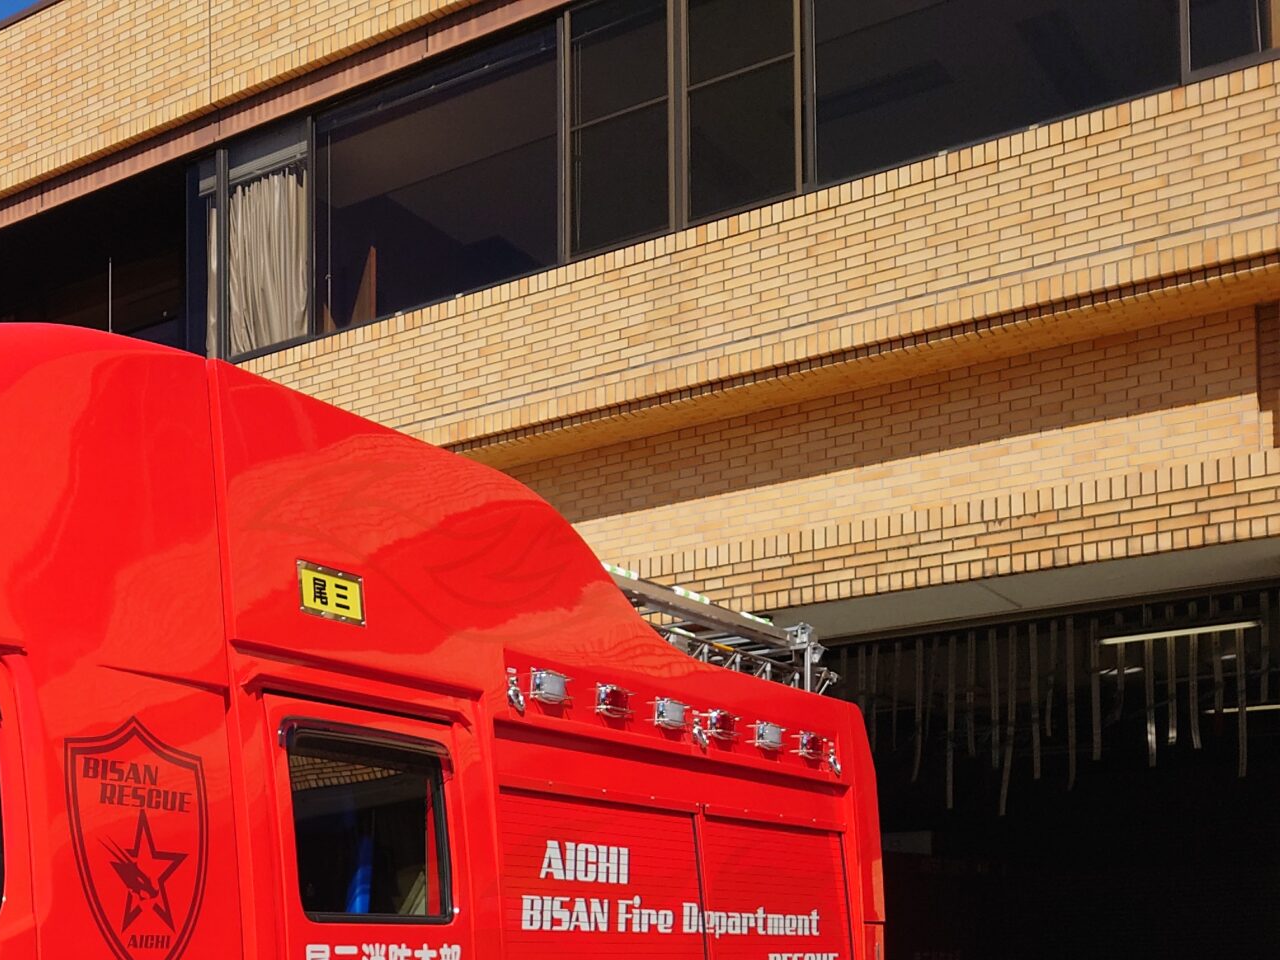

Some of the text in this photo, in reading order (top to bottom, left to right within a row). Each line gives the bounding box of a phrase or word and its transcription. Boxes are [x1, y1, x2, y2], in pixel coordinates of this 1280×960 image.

[312, 576, 351, 611] 尾三
[82, 757, 160, 786] BISAN
[99, 782, 193, 813] RESCUE
[539, 840, 629, 885] AICHI
[521, 895, 821, 939] BISAN Fire Department
[127, 934, 171, 950] AICHI
